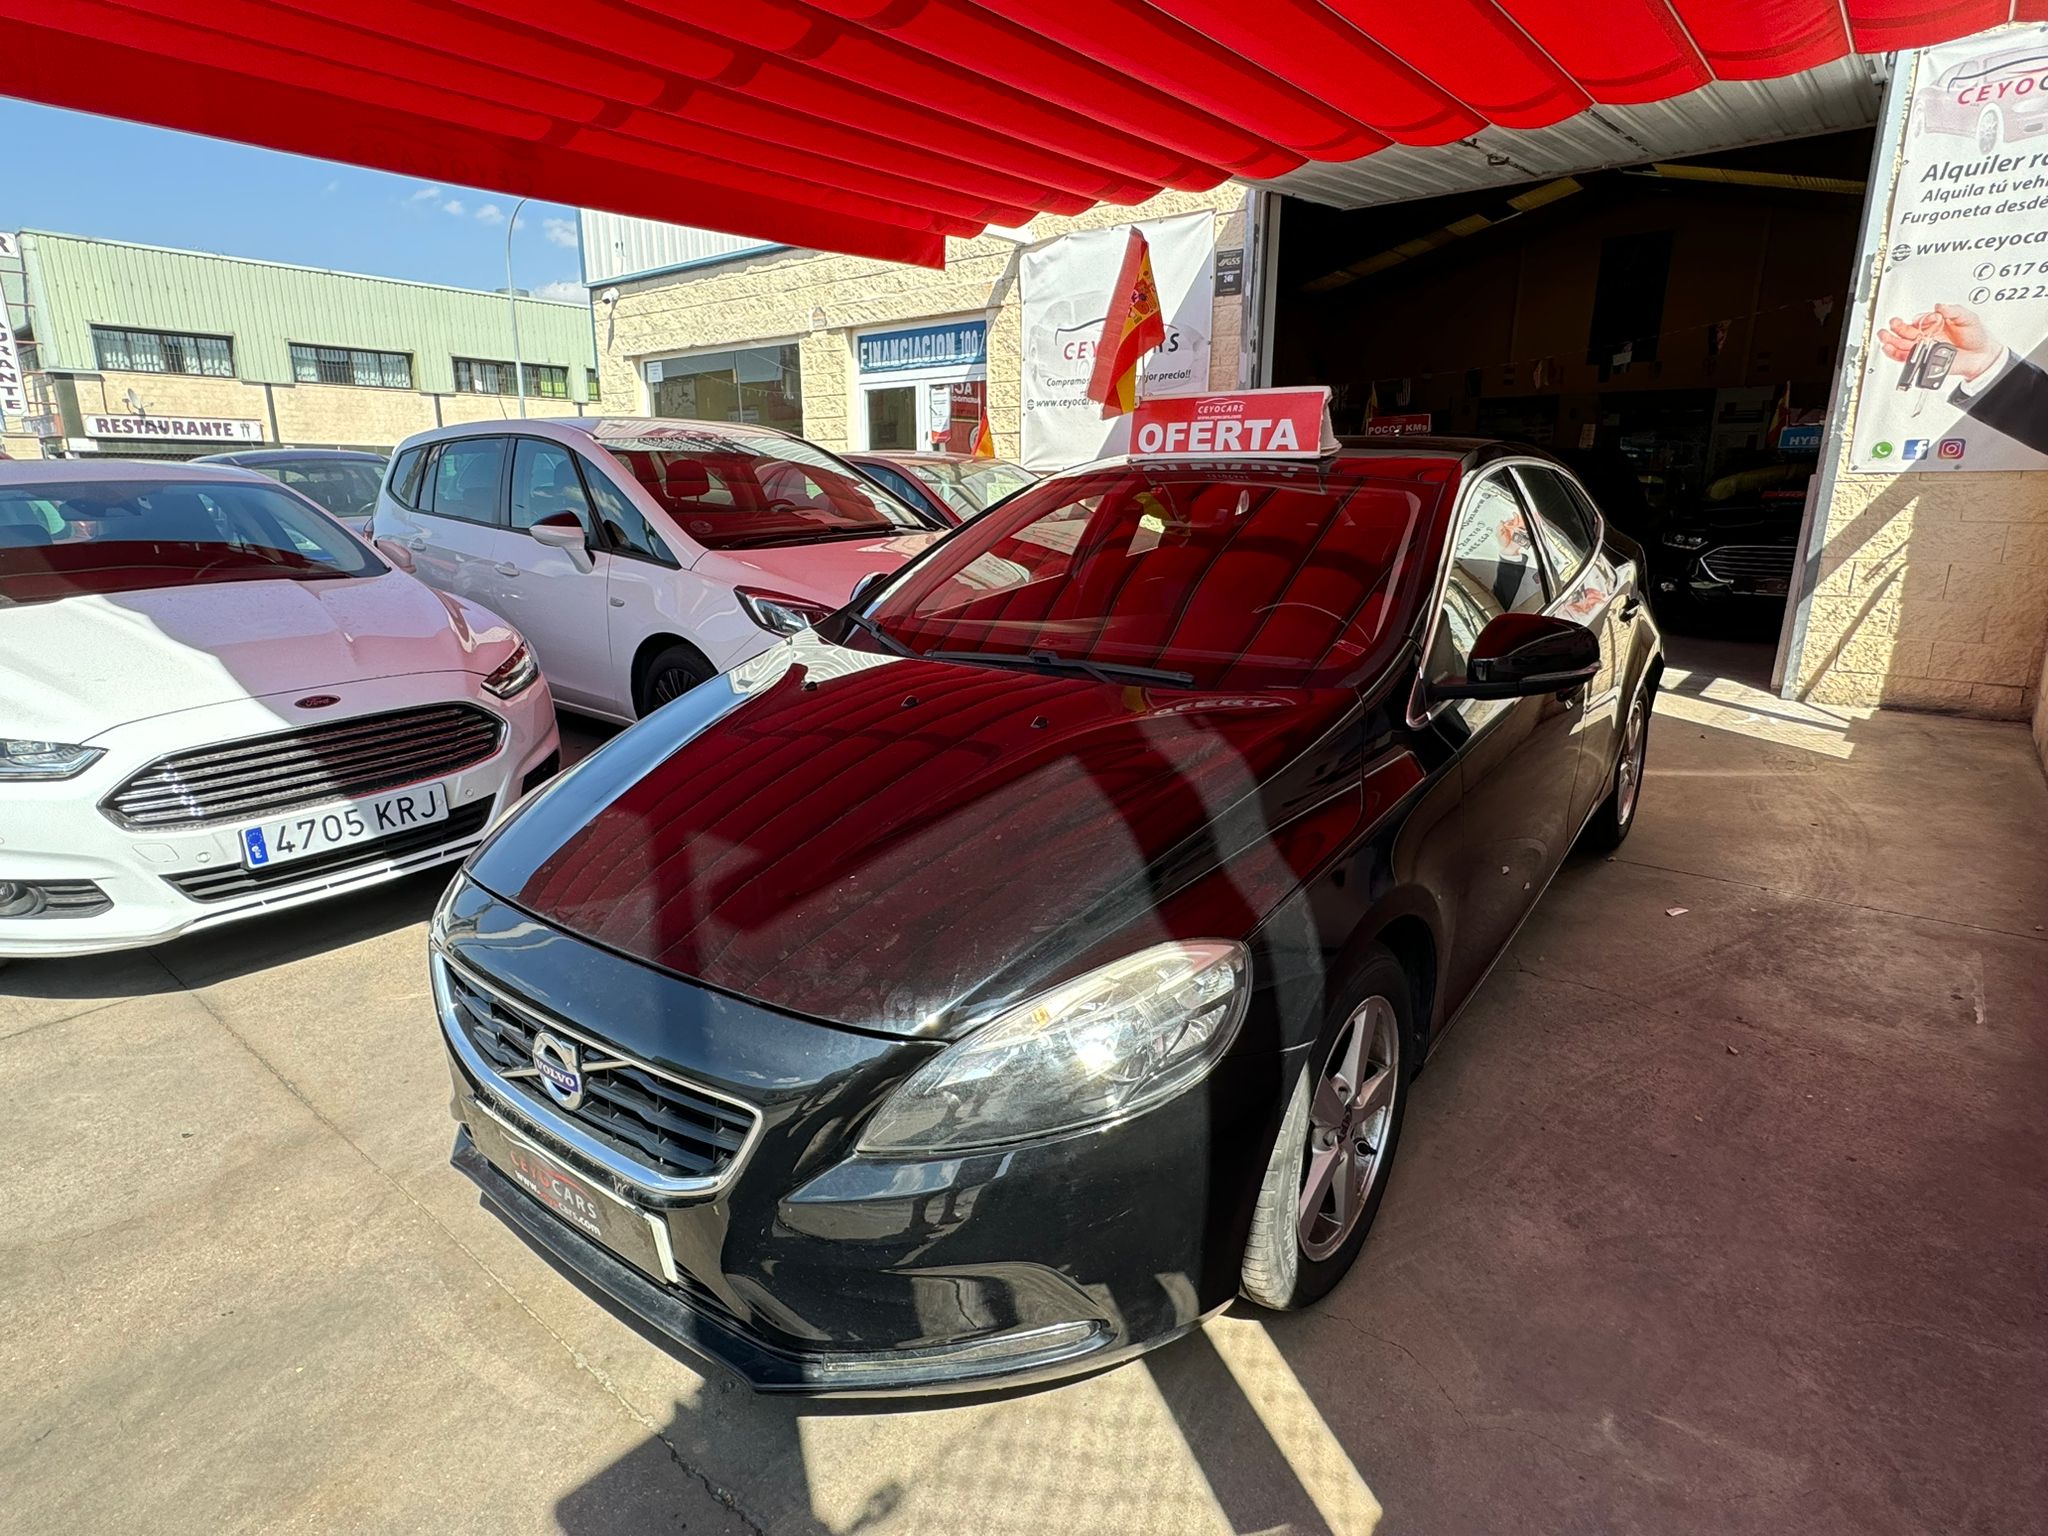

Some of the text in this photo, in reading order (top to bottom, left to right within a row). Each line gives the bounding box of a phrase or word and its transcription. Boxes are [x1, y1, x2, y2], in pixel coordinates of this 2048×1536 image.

[1920, 154, 2026, 184] Alquiler
[1920, 182, 1985, 204] Alquila
[1988, 178, 2009, 194] tú
[1900, 204, 1992, 226] Furgoneta
[1998, 261, 2036, 278] 617
[1993, 285, 2048, 302] 622 2
[860, 332, 956, 368] FINANCIACION
[1158, 369, 1192, 382] precio!!
[1197, 404, 1244, 414] CEYOCARS
[96, 418, 234, 437] RESTAURANTE
[1137, 418, 1299, 454] OFERTA
[276, 790, 437, 853] 4705 KRJ
[535, 1057, 576, 1088] VOLVO
[510, 1150, 598, 1220] CEYOCARS
